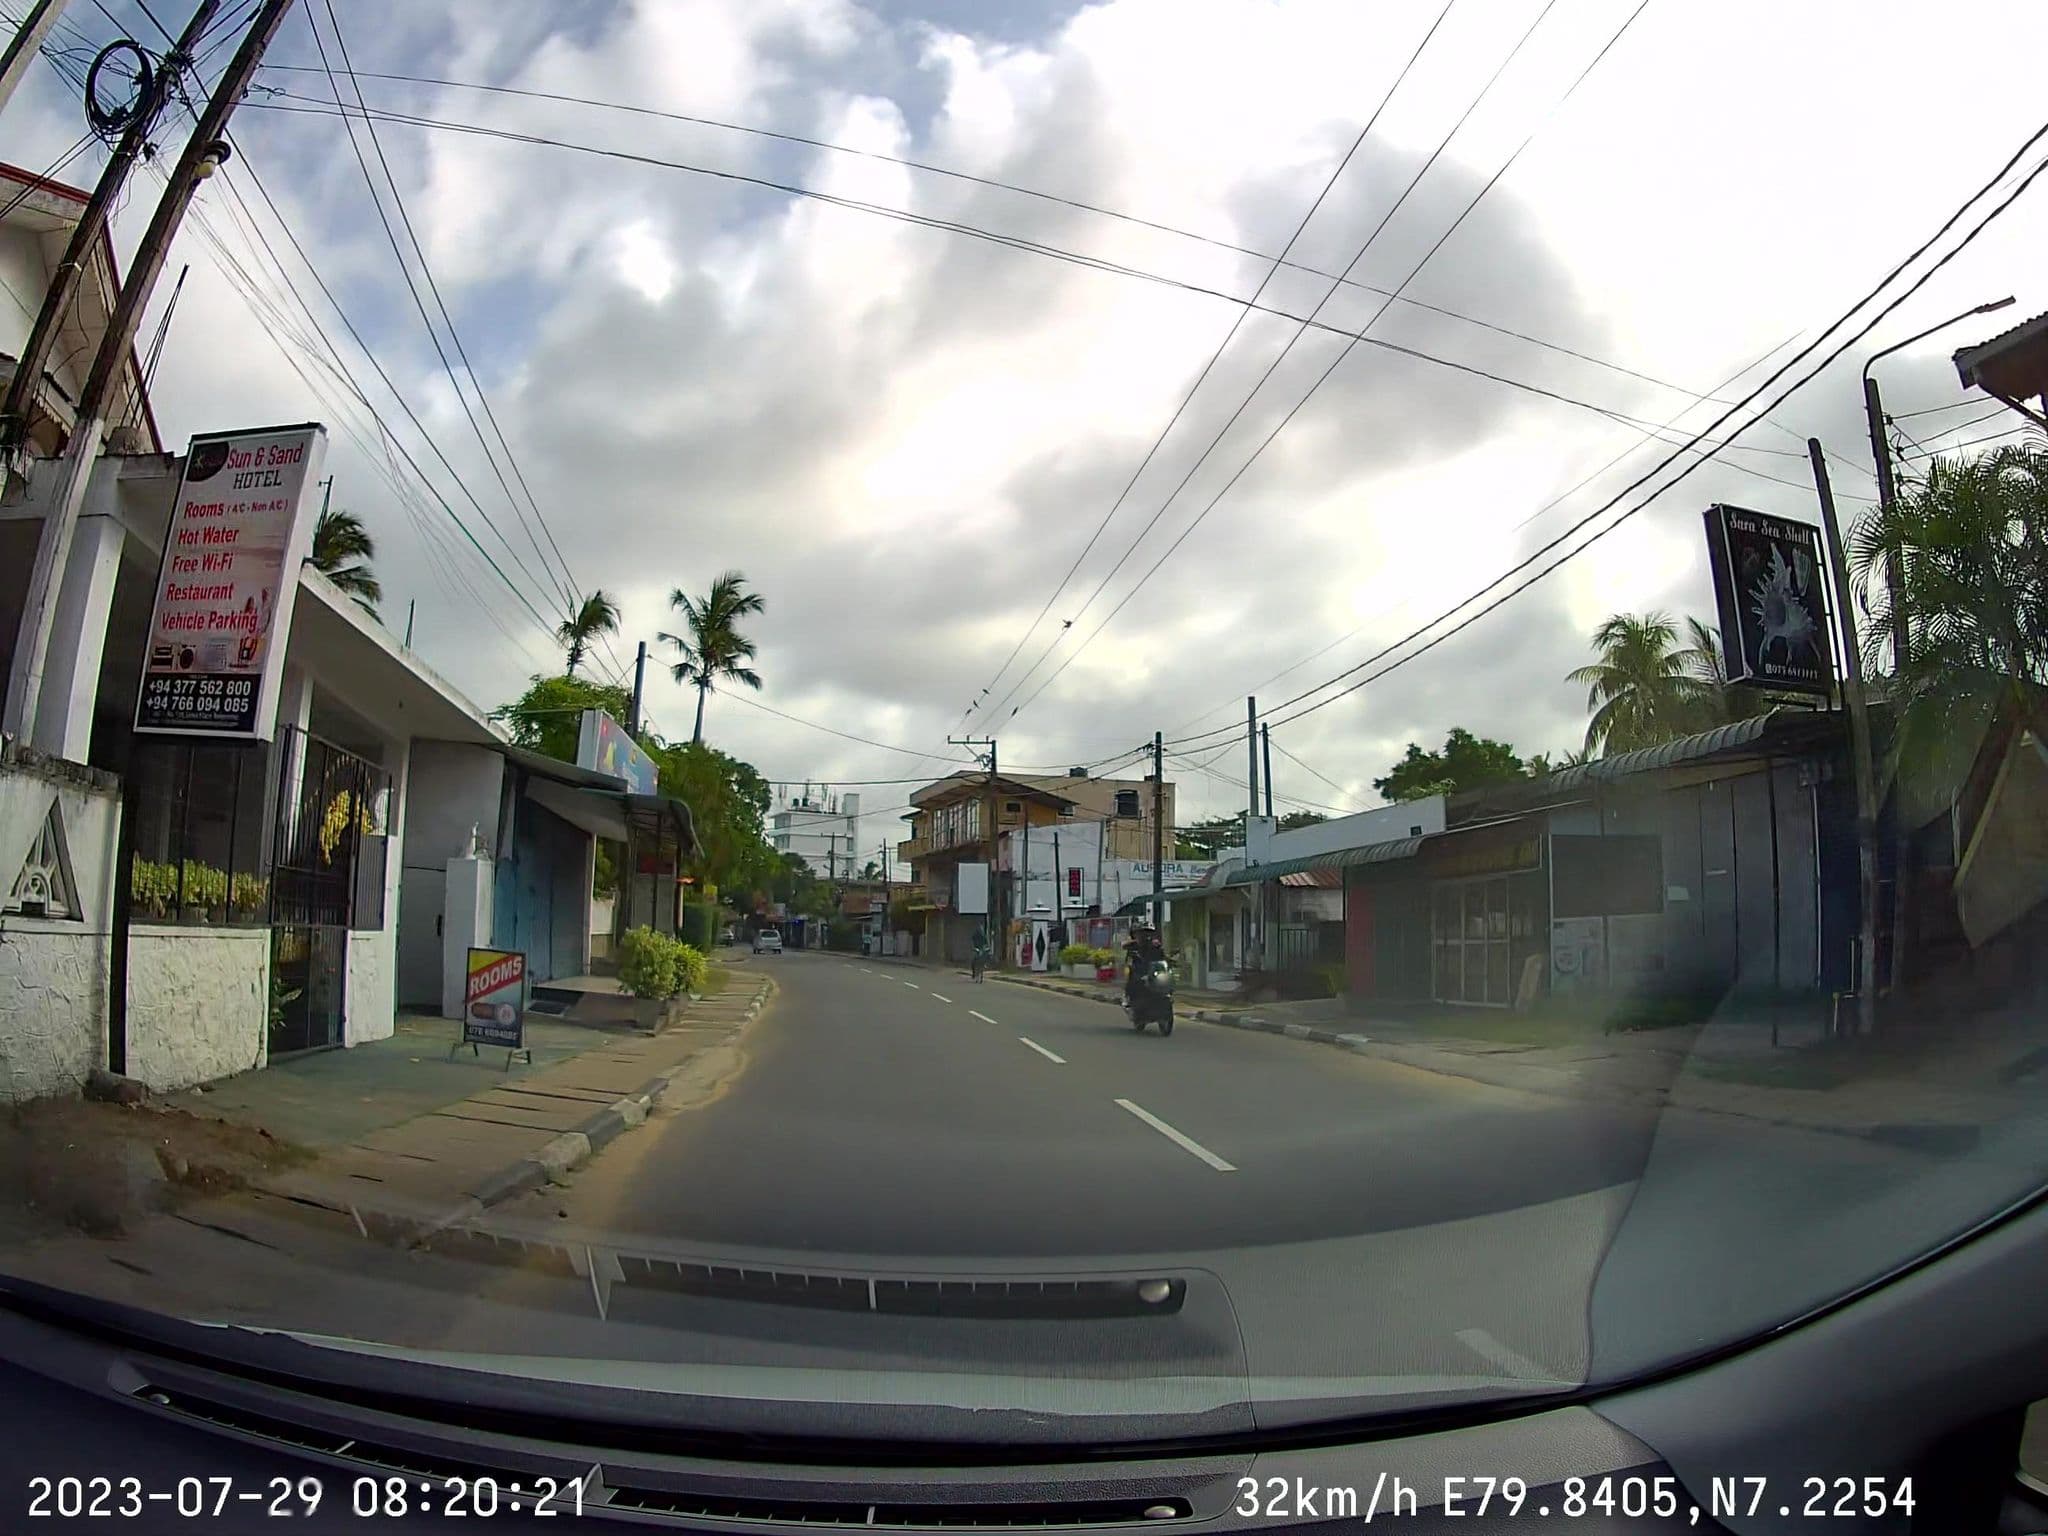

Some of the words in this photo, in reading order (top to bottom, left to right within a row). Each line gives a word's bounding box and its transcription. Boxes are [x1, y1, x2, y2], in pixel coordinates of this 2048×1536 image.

[227, 448, 251, 469] Sun
[255, 447, 264, 467] &
[268, 442, 304, 466] Sand
[233, 470, 282, 489] HOTEL
[184, 501, 224, 519] Rooms
[178, 528, 201, 545] Hot
[202, 526, 239, 544] Water
[1730, 512, 1756, 532] Sara
[1761, 519, 1780, 538] Sea
[1785, 525, 1809, 544] Shell
[172, 556, 199, 573] Free
[202, 552, 234, 571] Wi-Fi
[166, 583, 234, 600] Restaurant
[162, 611, 205, 630] Vehicle
[208, 610, 258, 633] Parking
[149, 680, 171, 694] +94
[173, 680, 197, 694] 377
[199, 681, 224, 695] 562
[226, 681, 251, 696] 800
[146, 696, 169, 710] +94
[196, 697, 220, 712] 094
[470, 956, 522, 996] ROOMS
